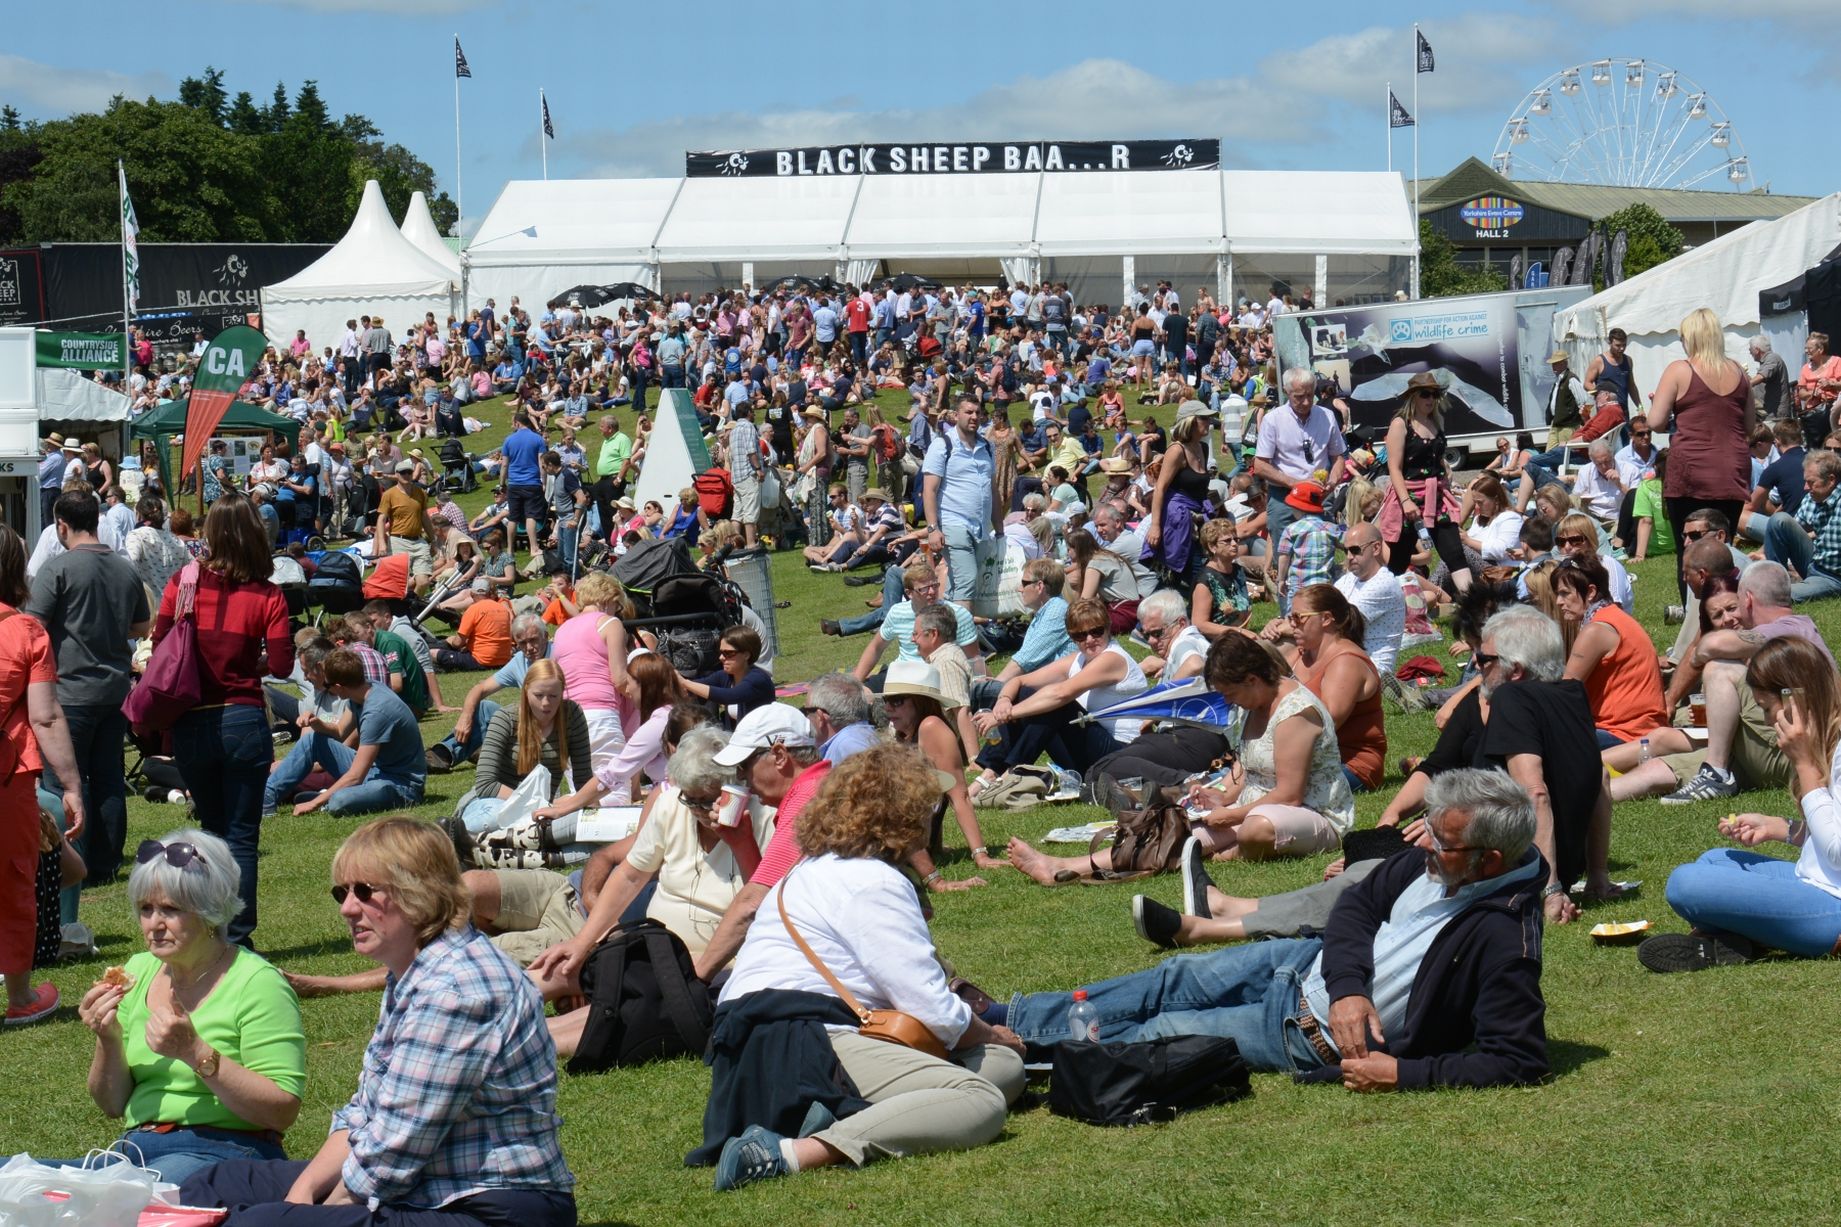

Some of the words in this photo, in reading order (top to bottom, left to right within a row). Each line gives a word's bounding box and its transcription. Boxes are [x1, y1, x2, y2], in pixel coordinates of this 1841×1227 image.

[776, 147, 877, 176] BLACK
[890, 145, 990, 173] SHEEP
[1476, 230, 1501, 238] HALL
[1502, 229, 1509, 238] 2
[176, 289, 231, 307] BLACK
[234, 289, 259, 306] SH
[856, 301, 865, 312] 3
[169, 319, 205, 337] Beers
[1415, 324, 1454, 340] wildlife
[1458, 322, 1488, 335] crime
[61, 339, 119, 350] COUNTRYSIDE
[61, 350, 119, 363] ALLIANCE
[208, 347, 245, 377] CA
[0, 462, 14, 473] KS
